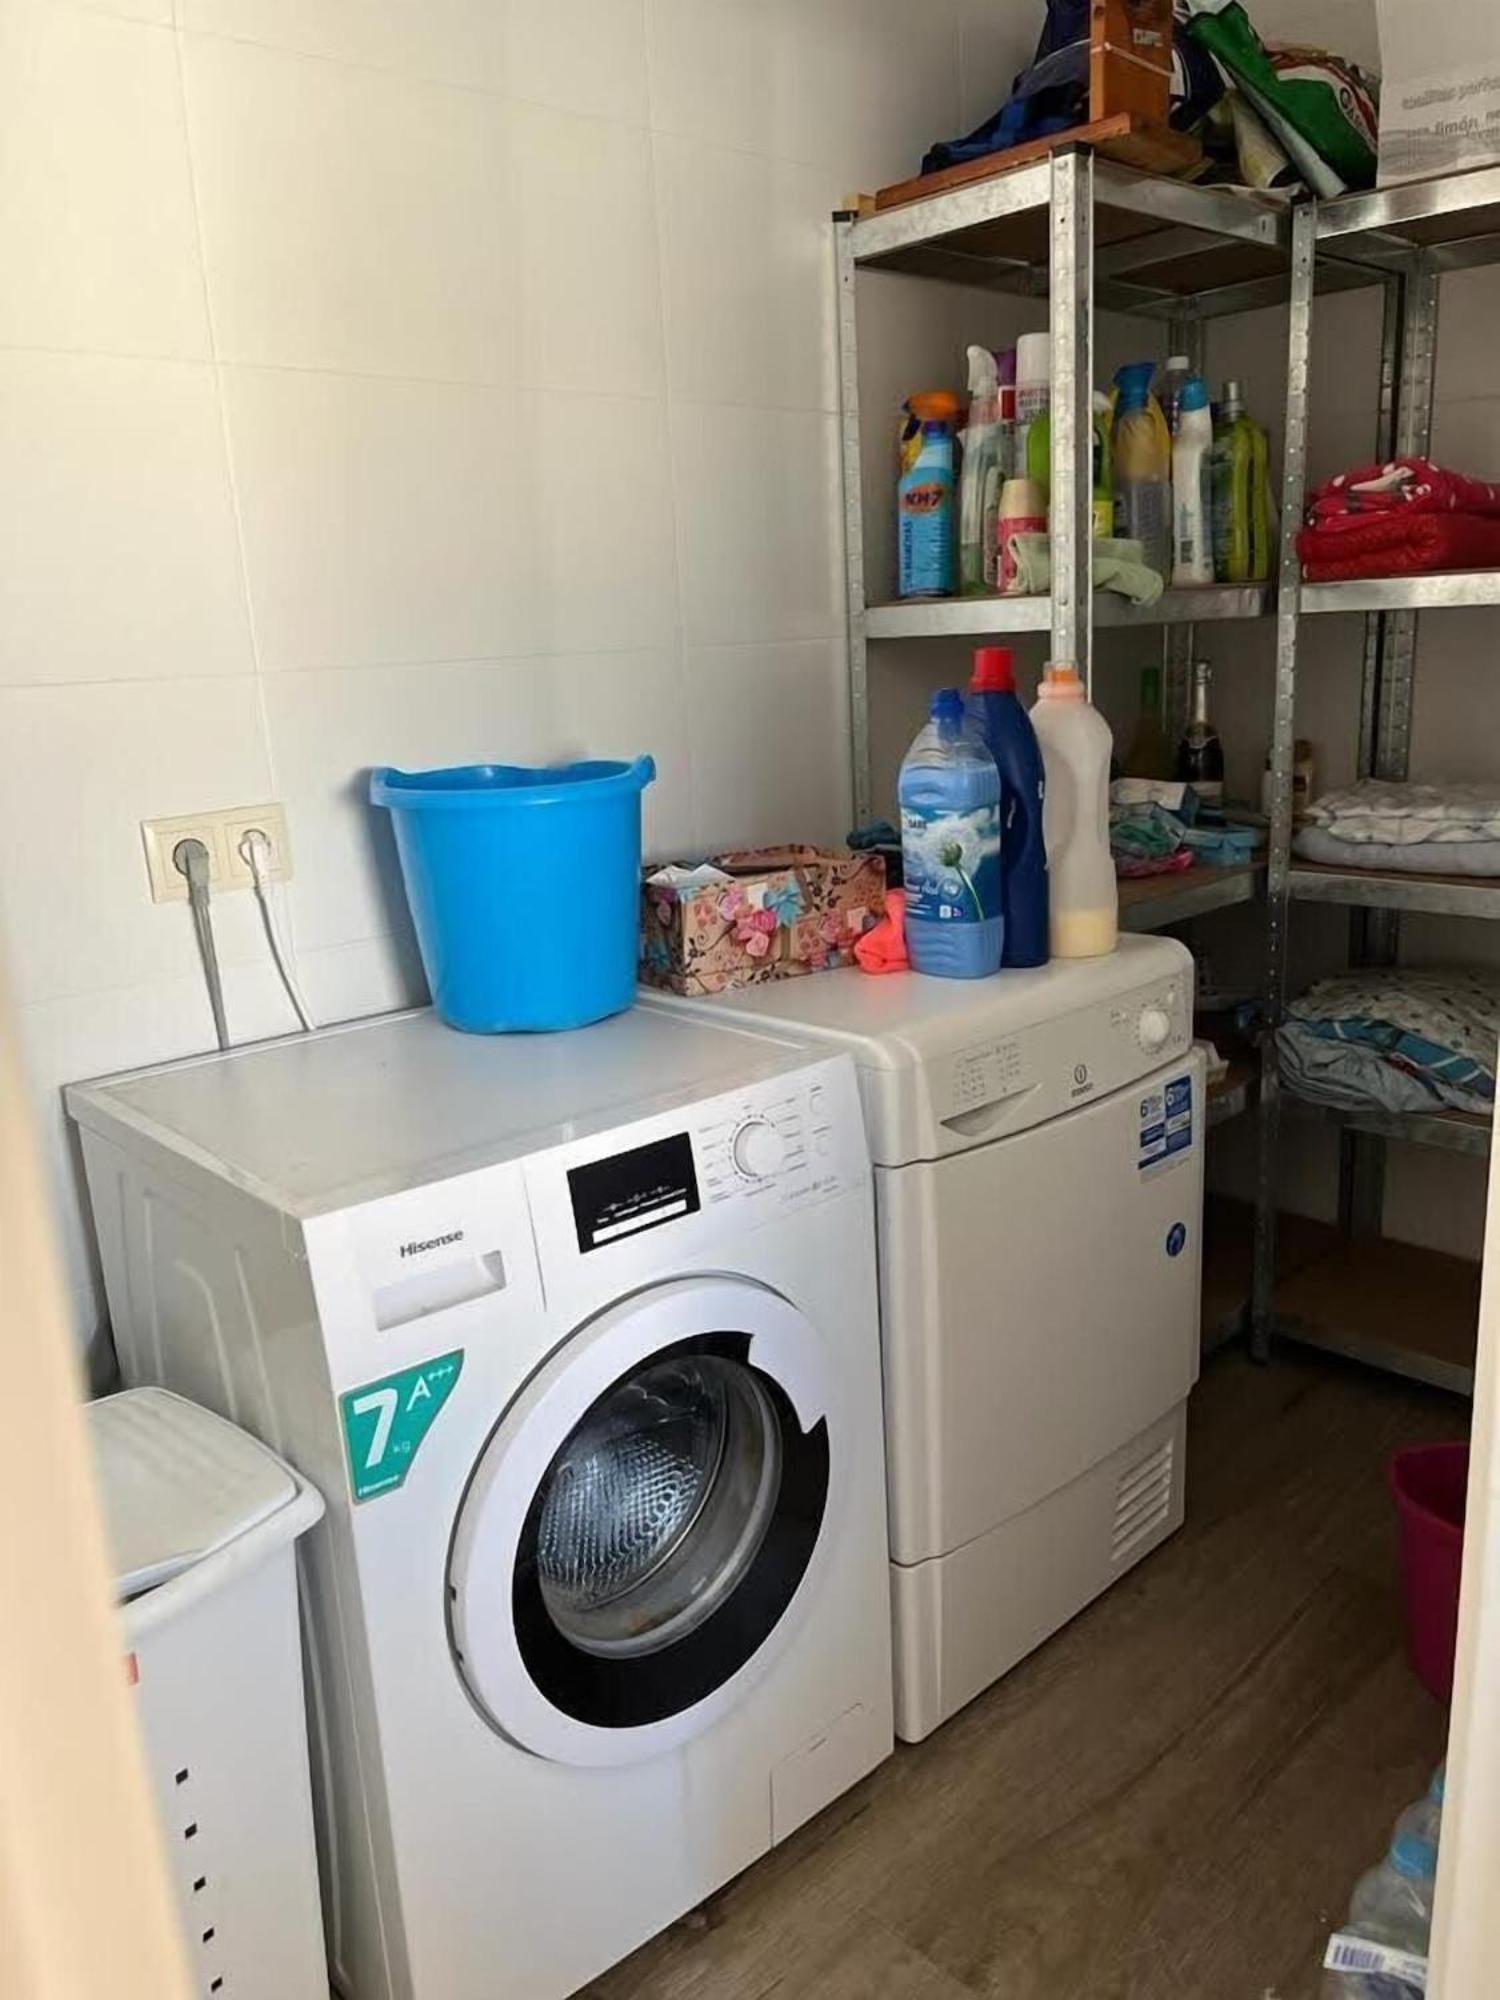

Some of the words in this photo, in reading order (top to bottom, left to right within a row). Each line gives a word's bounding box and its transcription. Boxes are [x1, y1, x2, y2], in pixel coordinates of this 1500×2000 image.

[1434, 115, 1478, 136] limón
[400, 1230, 464, 1258] Hisense
[352, 1387, 398, 1469] 7
